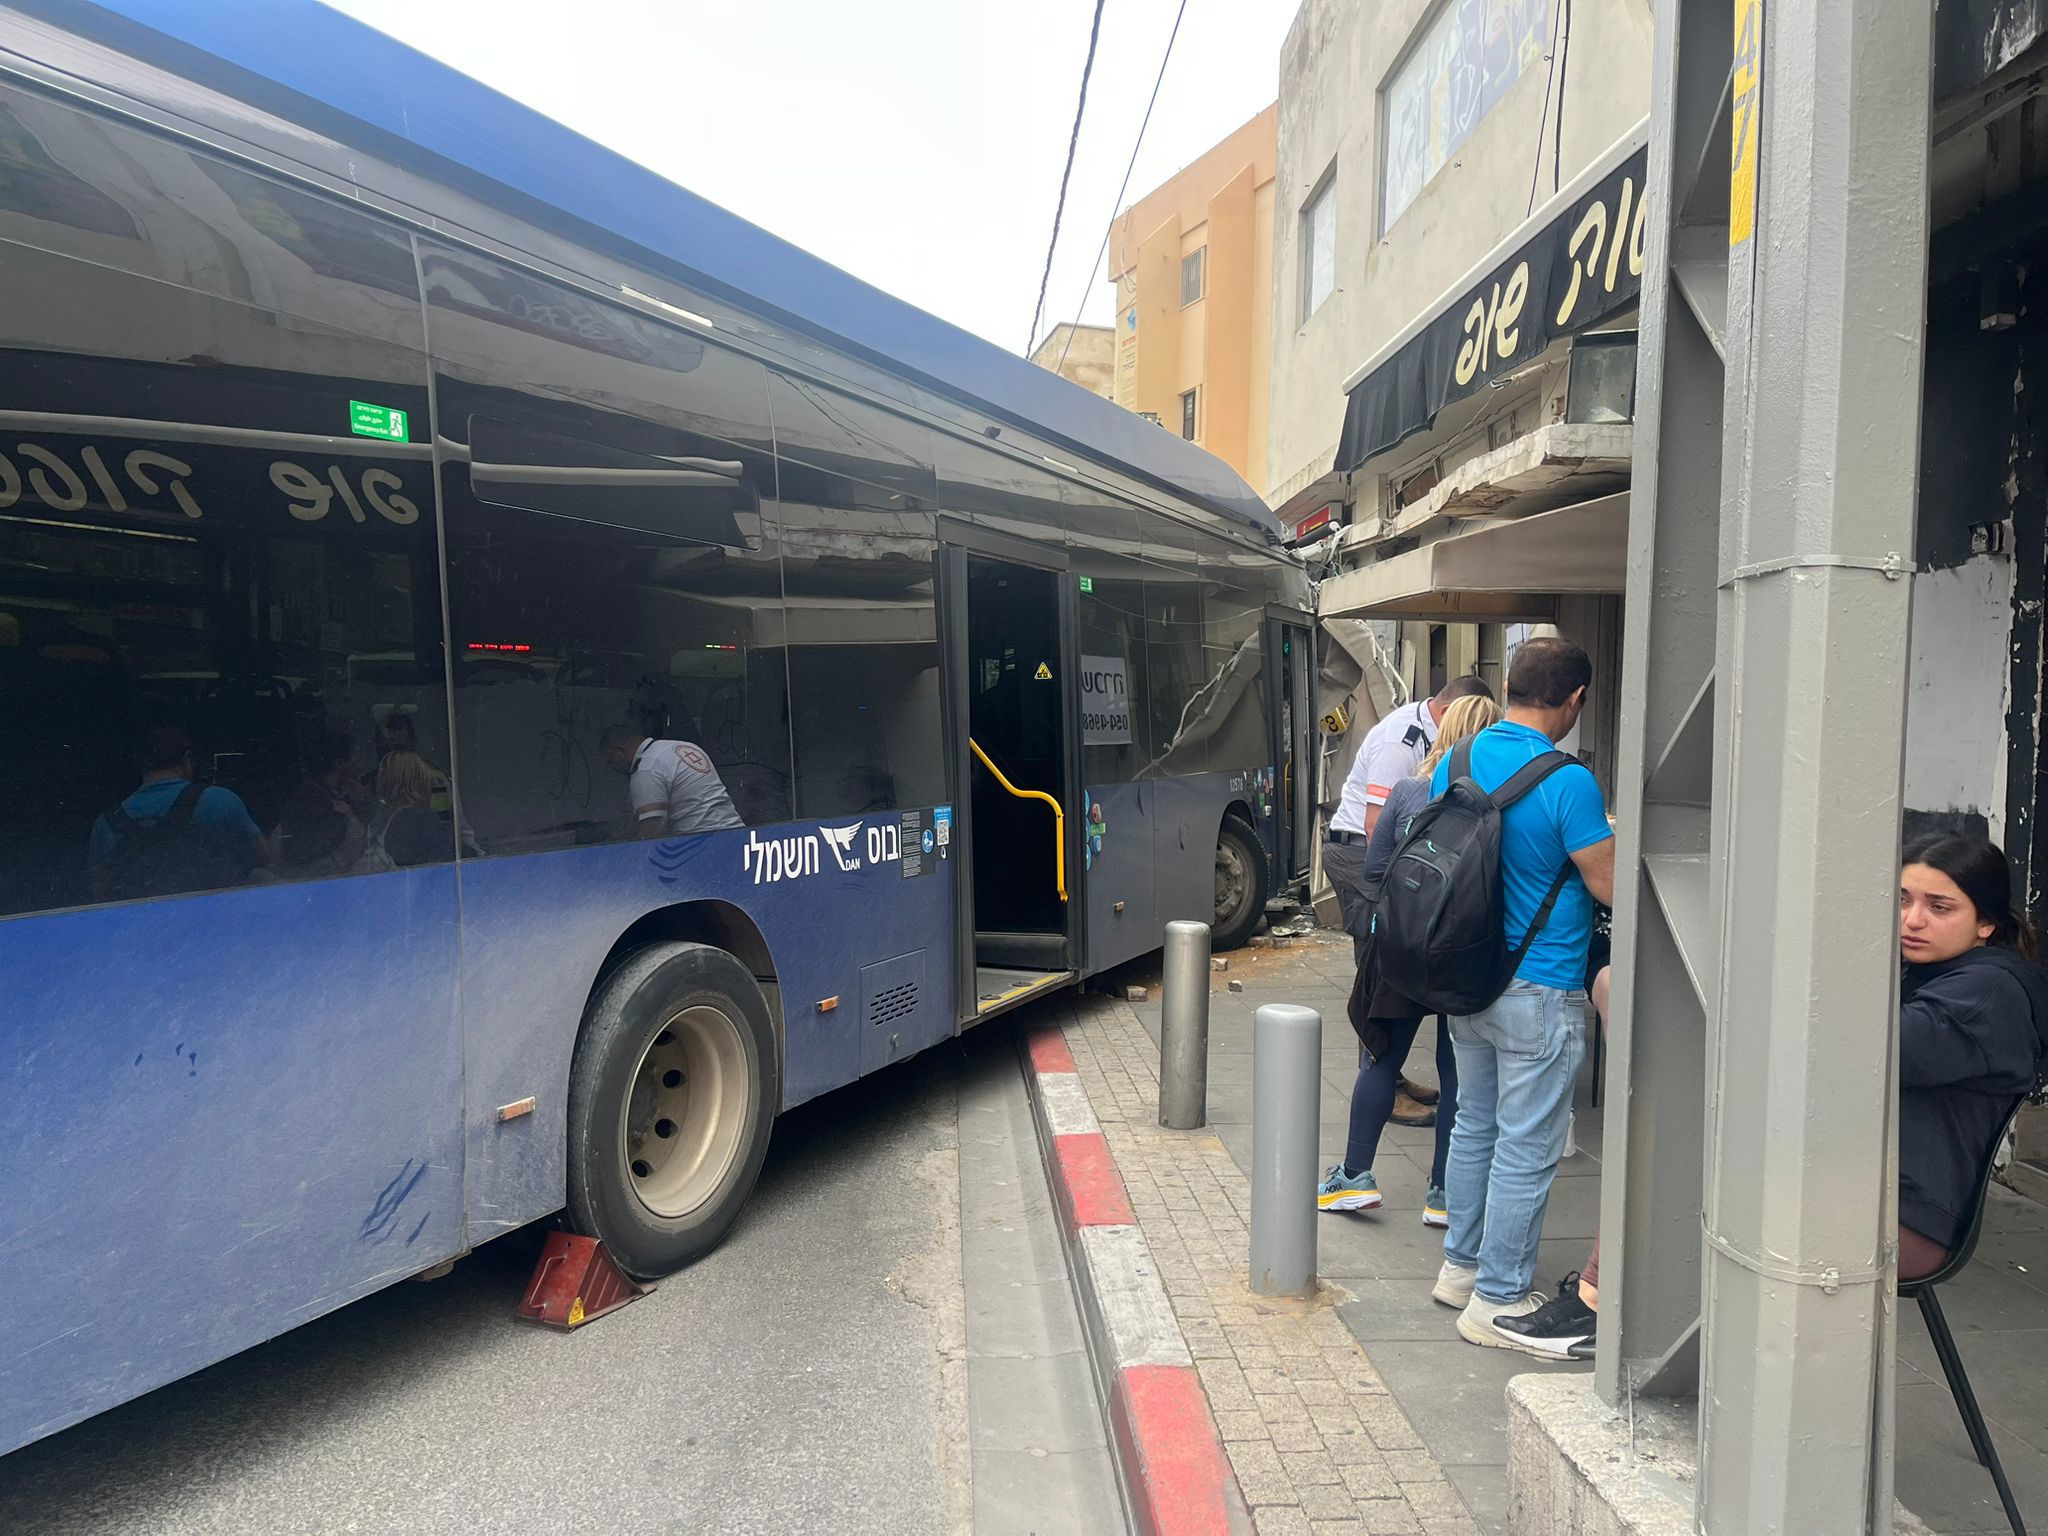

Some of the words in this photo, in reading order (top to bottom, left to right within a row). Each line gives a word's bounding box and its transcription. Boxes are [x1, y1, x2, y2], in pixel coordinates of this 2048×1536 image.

[1455, 261, 1529, 386] שופ
[744, 830, 820, 885] חשמלי
[845, 857, 861, 872] DAN
